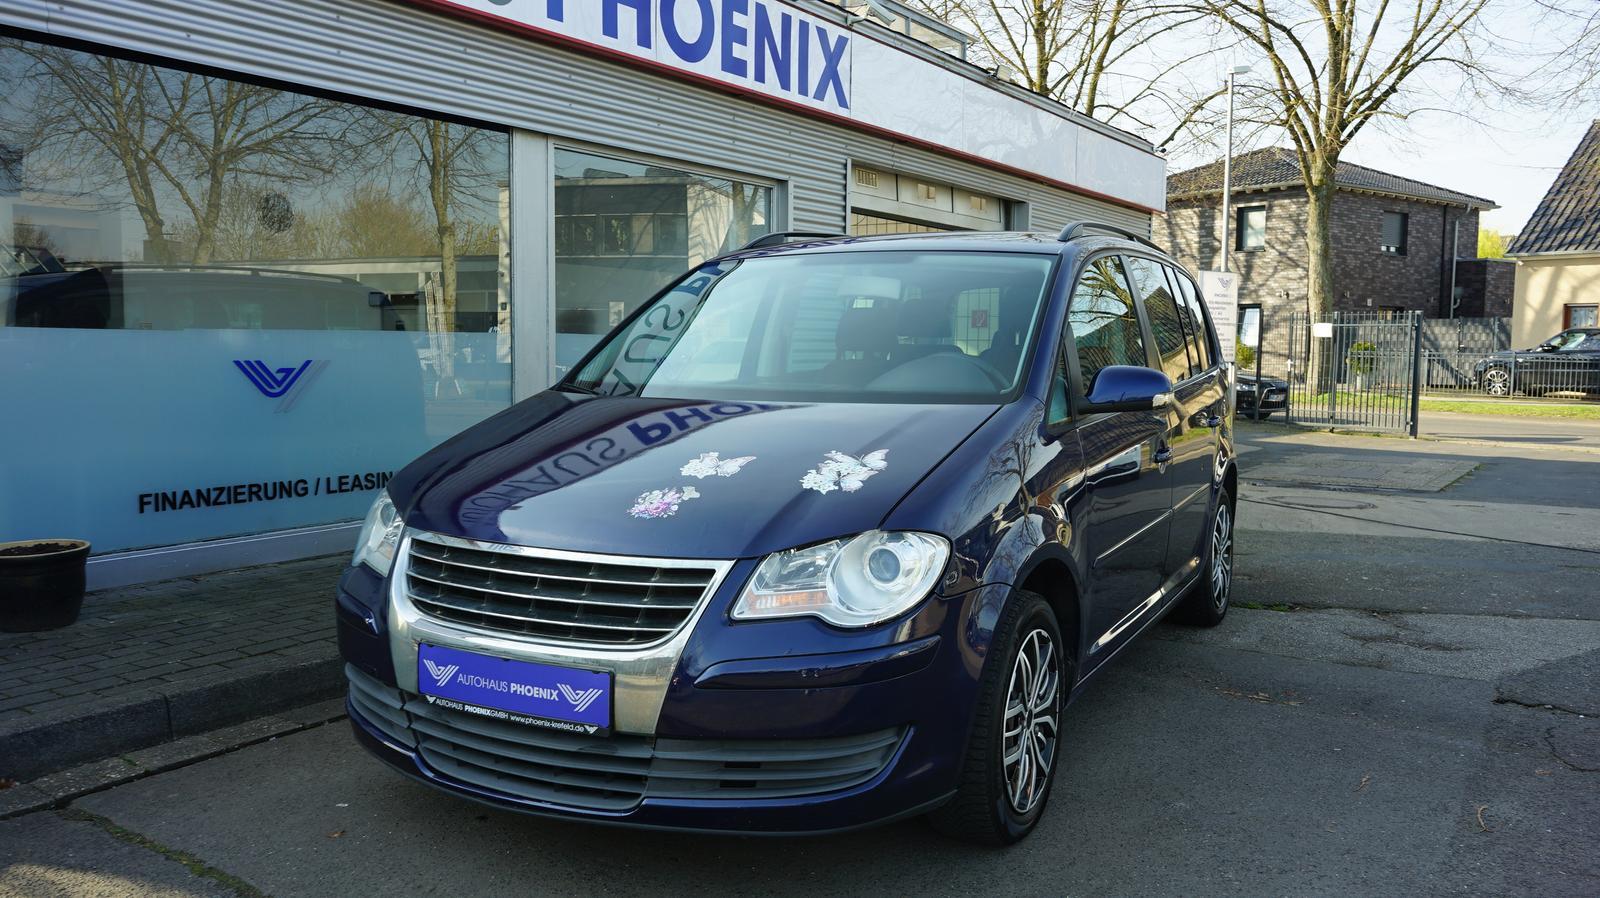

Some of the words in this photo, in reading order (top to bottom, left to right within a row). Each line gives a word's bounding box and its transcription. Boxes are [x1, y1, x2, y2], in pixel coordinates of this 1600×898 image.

[547, 0, 850, 110] HOENIX
[138, 478, 309, 514] FINANZIERUNG
[313, 477, 320, 496] /
[326, 471, 394, 495] LEASIN
[436, 699, 463, 710] AUTOHAUS
[457, 673, 508, 692] AUTOHAUS
[510, 683, 559, 701] PHOENIX
